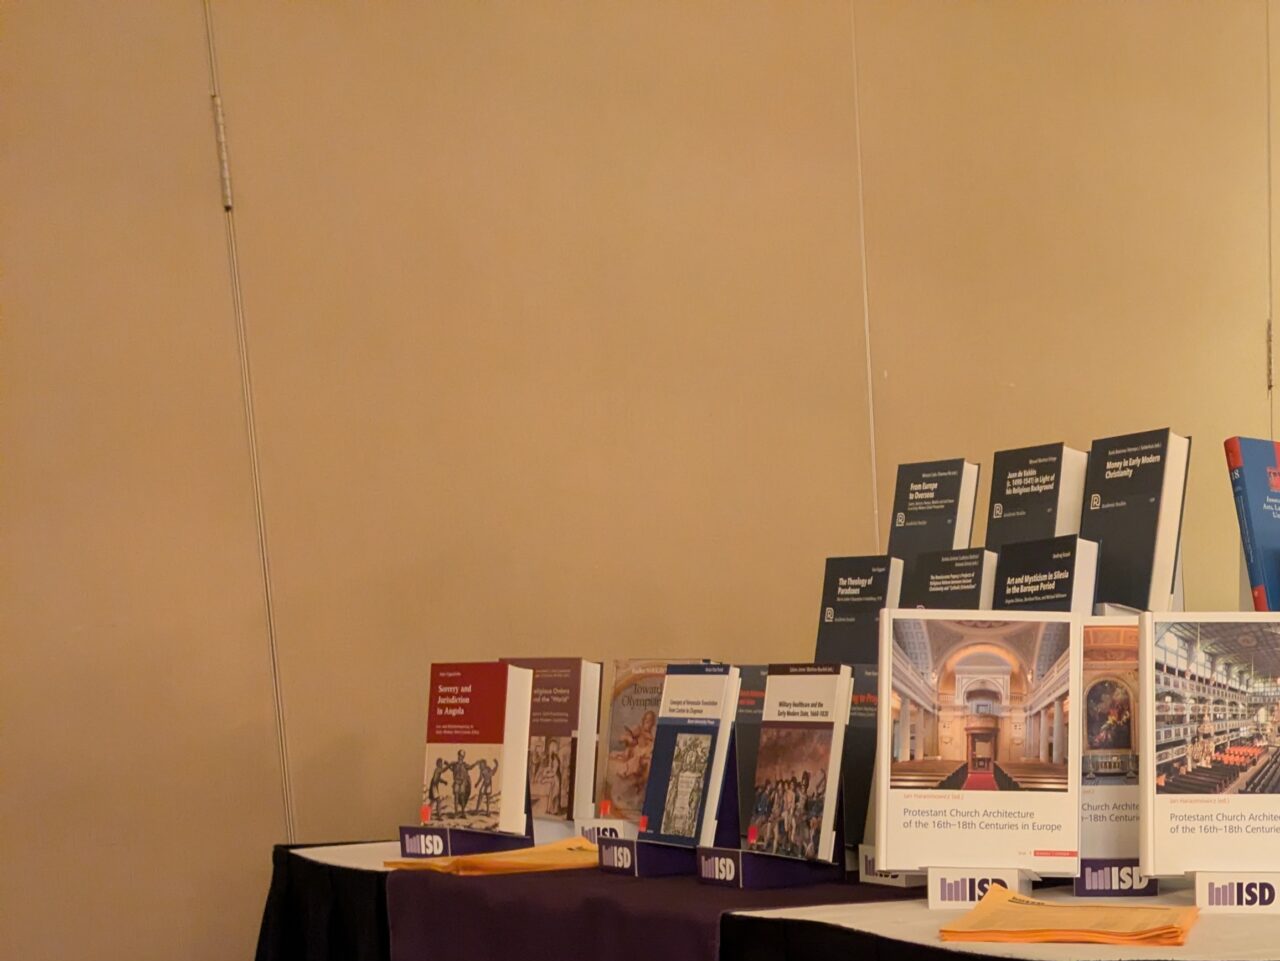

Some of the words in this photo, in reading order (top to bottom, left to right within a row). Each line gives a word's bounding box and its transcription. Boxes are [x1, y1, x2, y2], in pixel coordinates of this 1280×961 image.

[461, 684, 472, 693] and
[444, 707, 464, 717] Angola
[903, 807, 947, 817] Protestant
[950, 808, 979, 818] Church
[982, 809, 1034, 818] Architecture
[1082, 802, 1109, 812] Church
[1170, 813, 1213, 822] Protestant
[1216, 813, 1245, 822] Church
[903, 820, 912, 829] of
[914, 820, 929, 829] the
[932, 820, 976, 830] 16th–18th
[979, 821, 1019, 830] Centuries
[1021, 821, 1029, 831] in
[1032, 822, 1062, 833] Europe
[1170, 825, 1179, 834] of
[1182, 825, 1196, 834] the
[1199, 825, 1243, 834] 16th–18th
[421, 835, 443, 855] ISD
[614, 846, 631, 868] ISD
[714, 856, 735, 880] ISD
[1112, 867, 1148, 890] ISD
[1236, 882, 1275, 906] ISD
